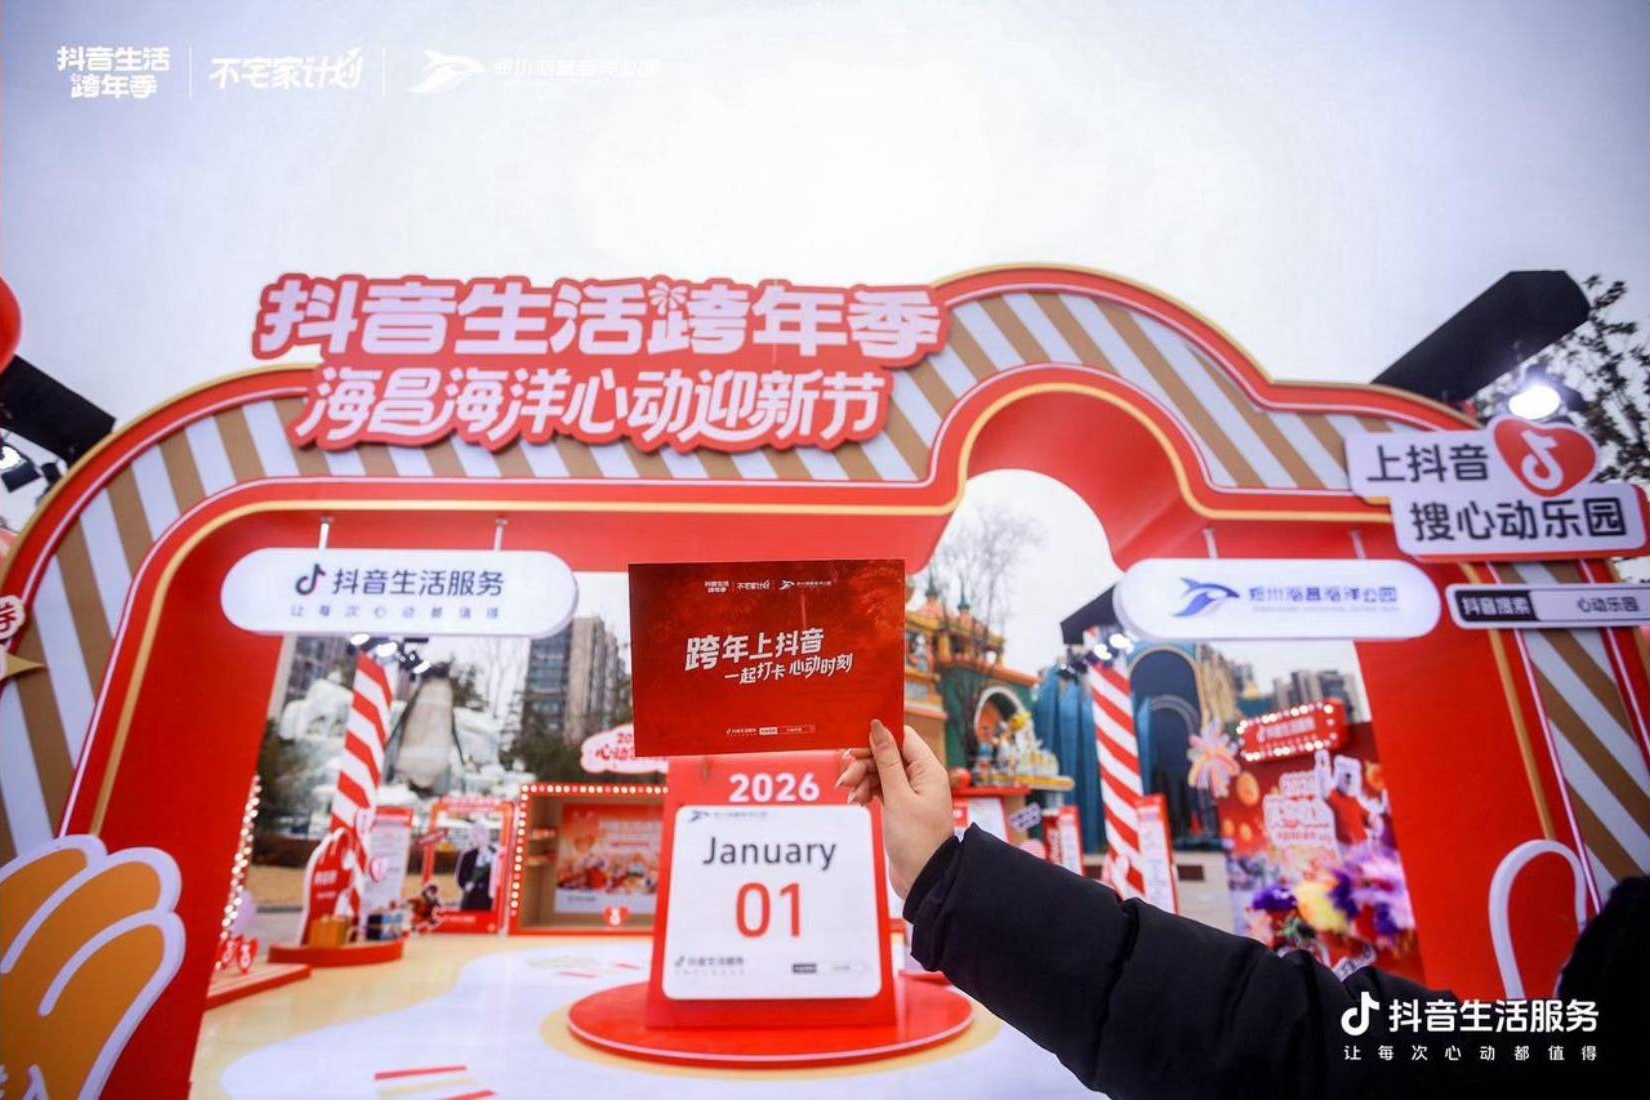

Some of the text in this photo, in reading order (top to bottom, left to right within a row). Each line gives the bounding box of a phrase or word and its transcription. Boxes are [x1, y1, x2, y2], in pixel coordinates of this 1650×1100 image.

[261, 280, 941, 358] 抖音生活跨年季
[295, 367, 886, 440] 海昌海洋心动迎新节
[1367, 444, 1489, 482] 上抖音
[1410, 497, 1627, 541] 搜心动乐园
[331, 568, 504, 596] 抖音生活服务
[685, 627, 824, 672] 跨年上抖音
[724, 654, 853, 685] 一起打卡 心动时刻
[728, 772, 820, 802] 2026
[702, 837, 837, 872] January
[736, 882, 800, 938] 01
